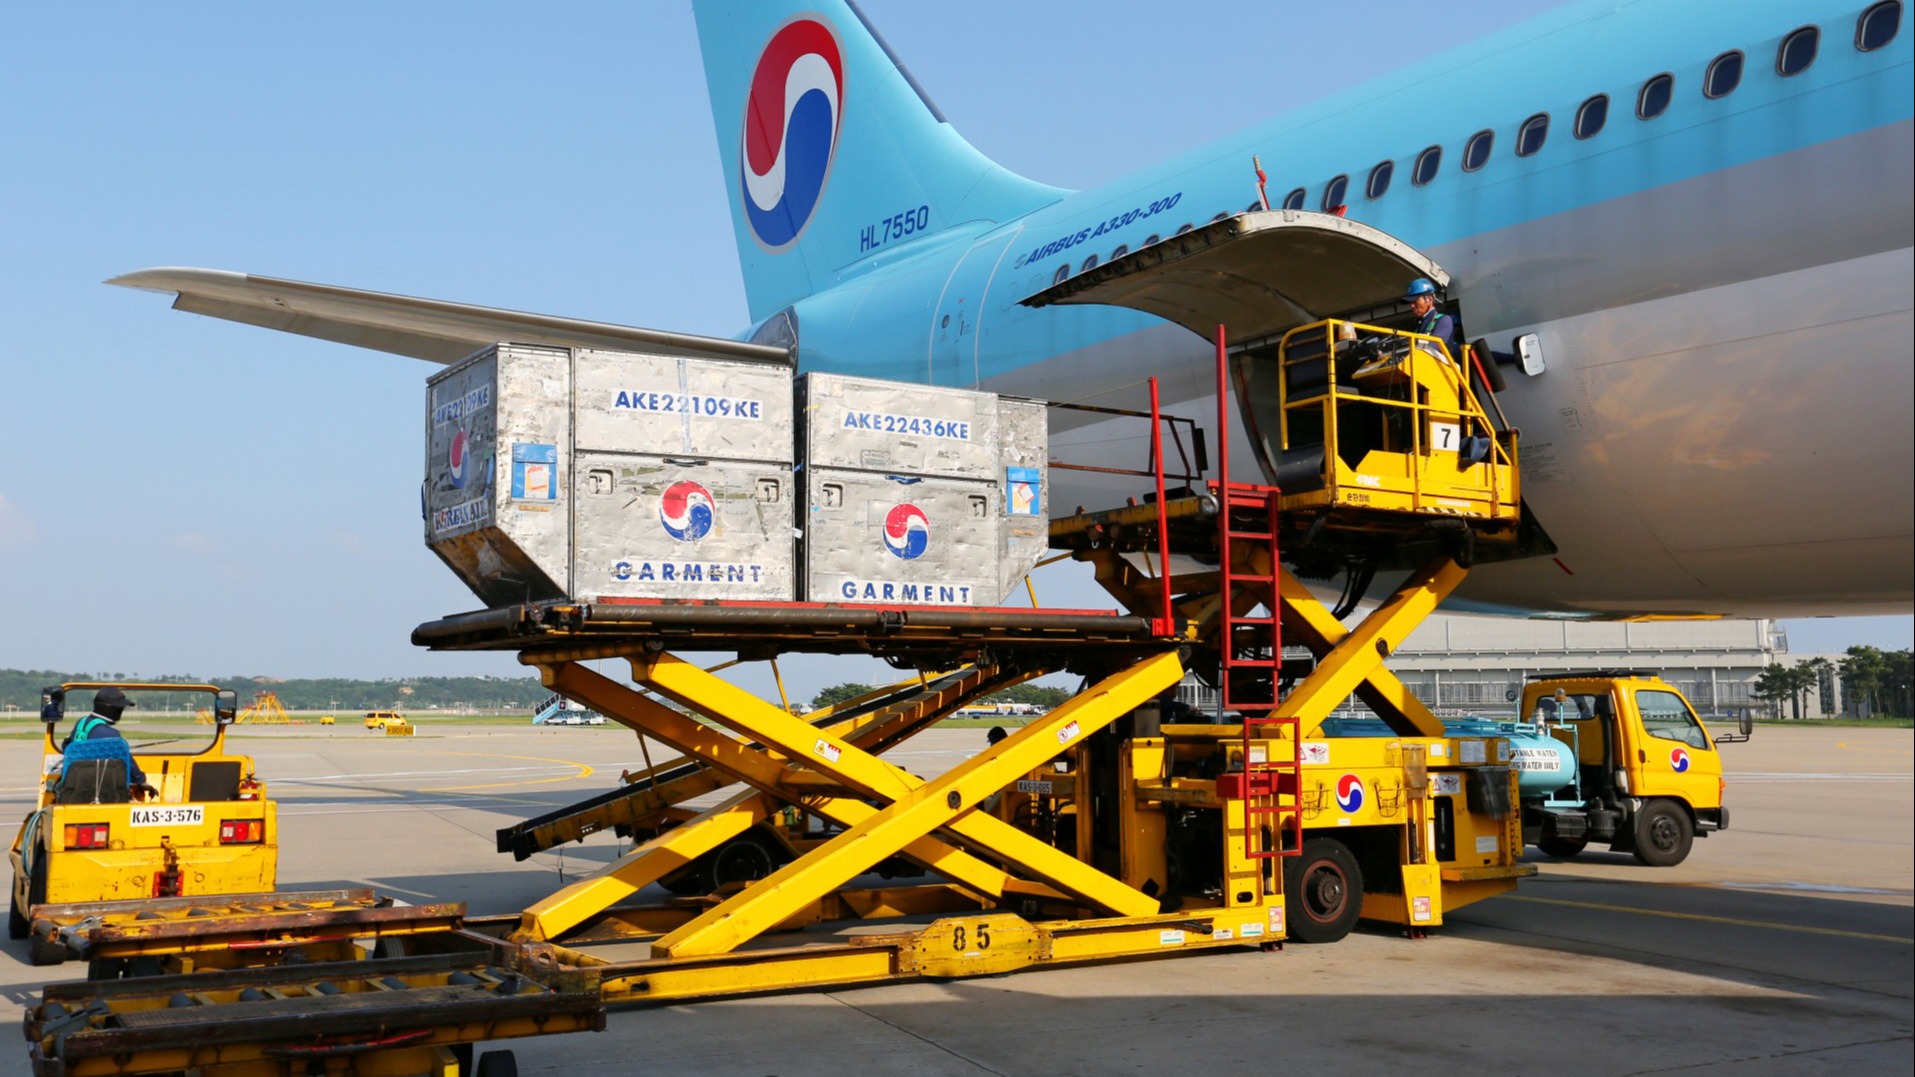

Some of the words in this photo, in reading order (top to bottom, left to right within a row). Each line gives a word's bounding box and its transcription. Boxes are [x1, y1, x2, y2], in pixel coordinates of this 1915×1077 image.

[860, 205, 929, 253] HL7550
[1025, 227, 1092, 266] AIRBUS
[1090, 192, 1182, 239] A330-300
[615, 391, 760, 418] AKE22109KE
[843, 411, 969, 439] AKE22436KE
[1441, 428, 1451, 448] 7
[615, 561, 761, 582] GARMENT
[841, 581, 970, 603] GARMENT
[132, 809, 201, 823] KAS-3-576
